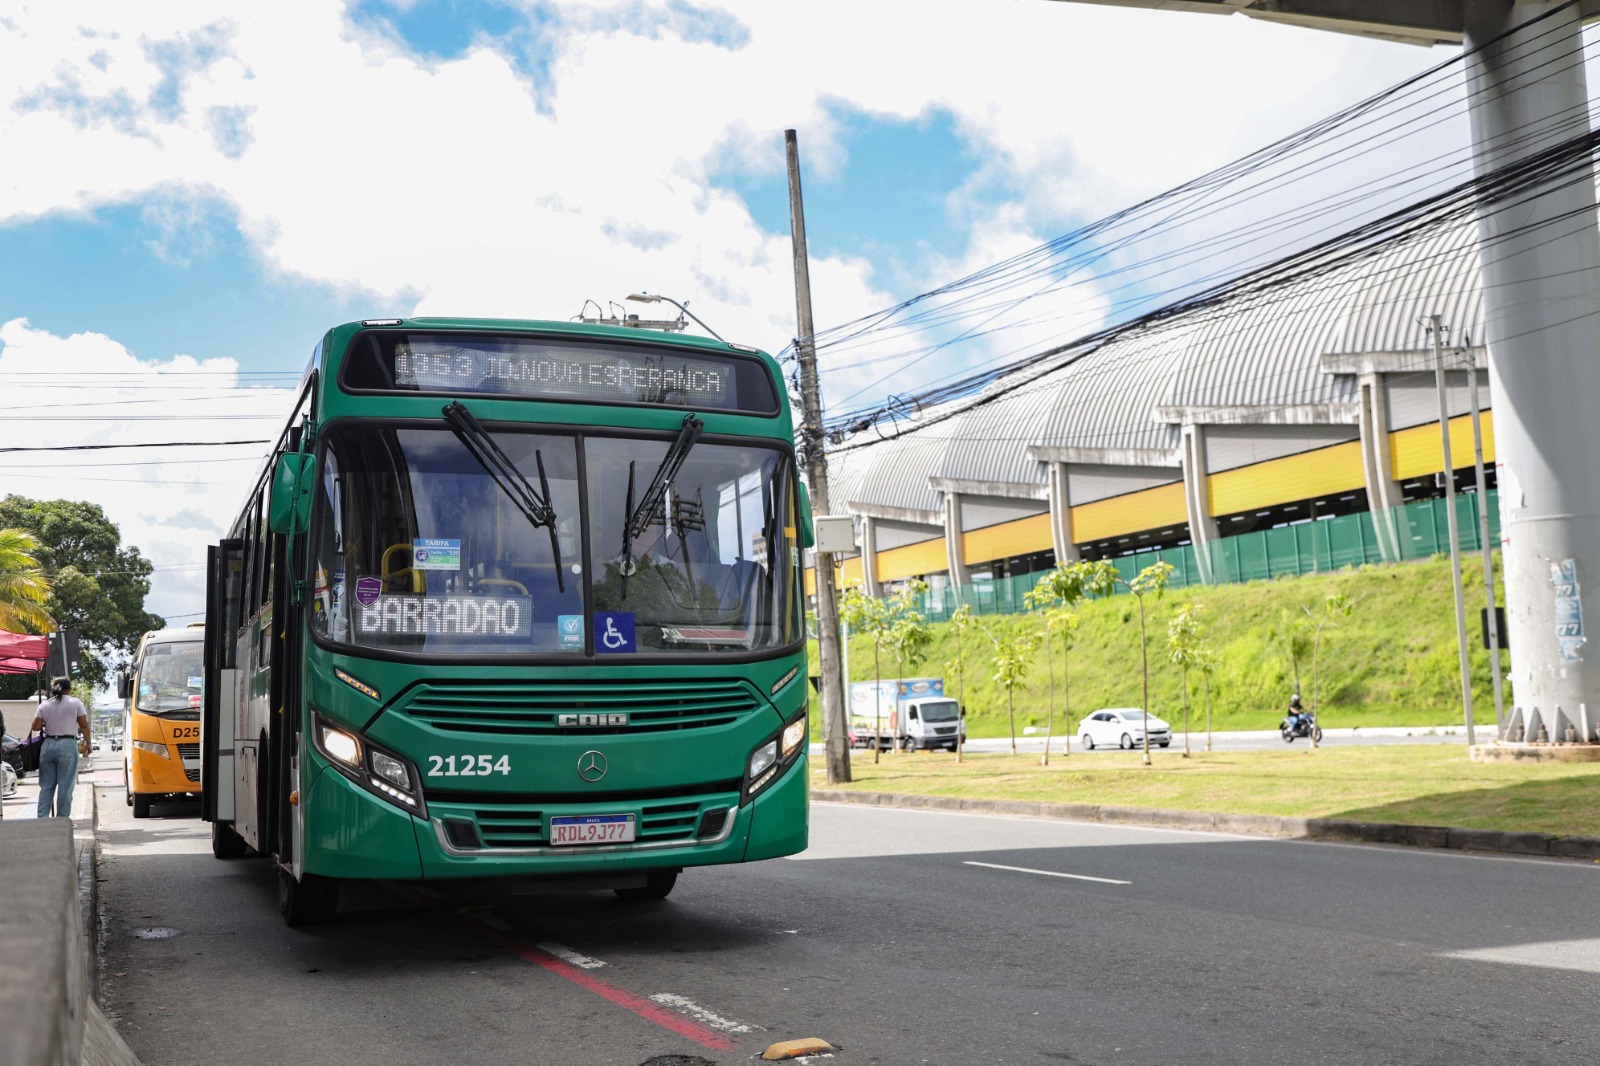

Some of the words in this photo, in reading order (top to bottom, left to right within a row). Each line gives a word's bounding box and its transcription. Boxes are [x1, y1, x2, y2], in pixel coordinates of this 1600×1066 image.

[398, 352, 472, 377] 1353
[589, 364, 720, 392] ESPERANCA
[424, 539, 450, 547] TARIFA
[361, 597, 520, 634] BARRADAO
[1557, 623, 1580, 636] 77
[558, 713, 627, 727] CAIO
[427, 754, 511, 777] 21254
[558, 823, 626, 842] RDL9J77
